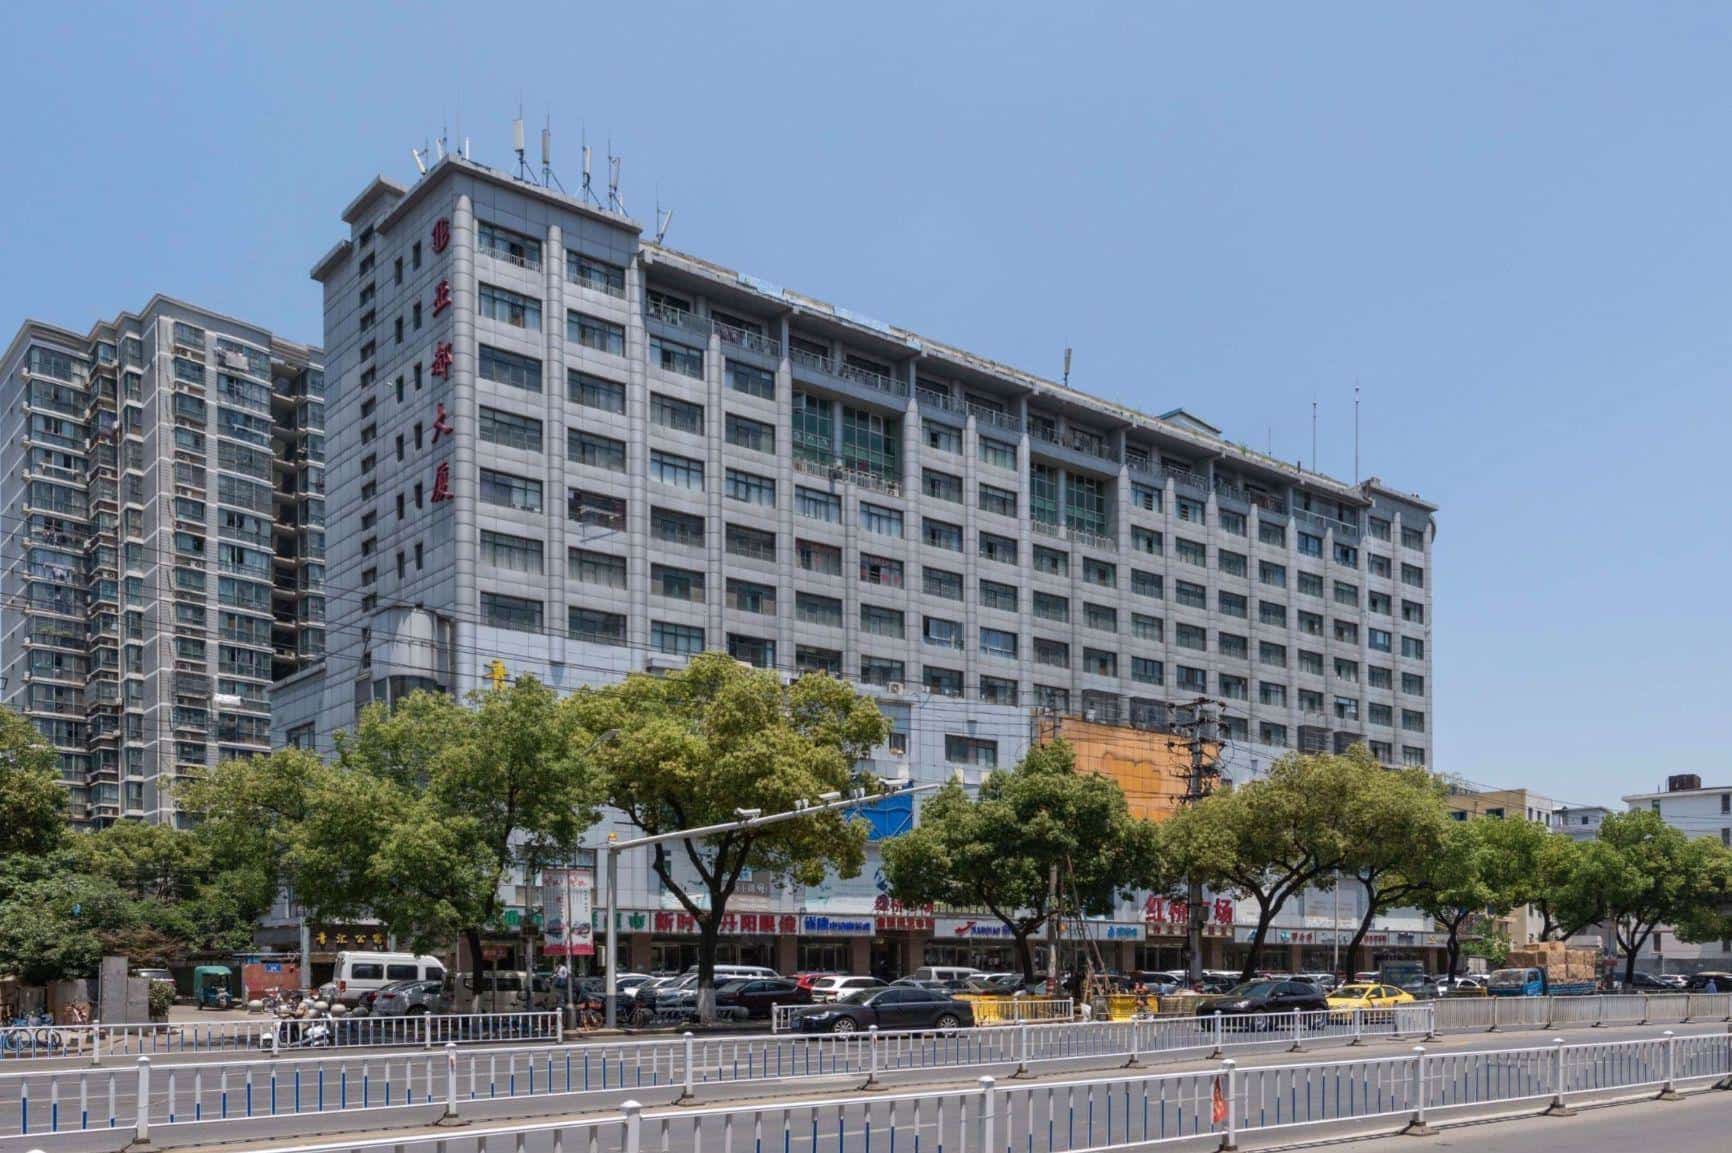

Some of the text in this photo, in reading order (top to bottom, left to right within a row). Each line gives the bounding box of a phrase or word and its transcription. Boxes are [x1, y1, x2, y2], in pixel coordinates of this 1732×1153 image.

[654, 911, 797, 934] 新时丹阳眼镜
